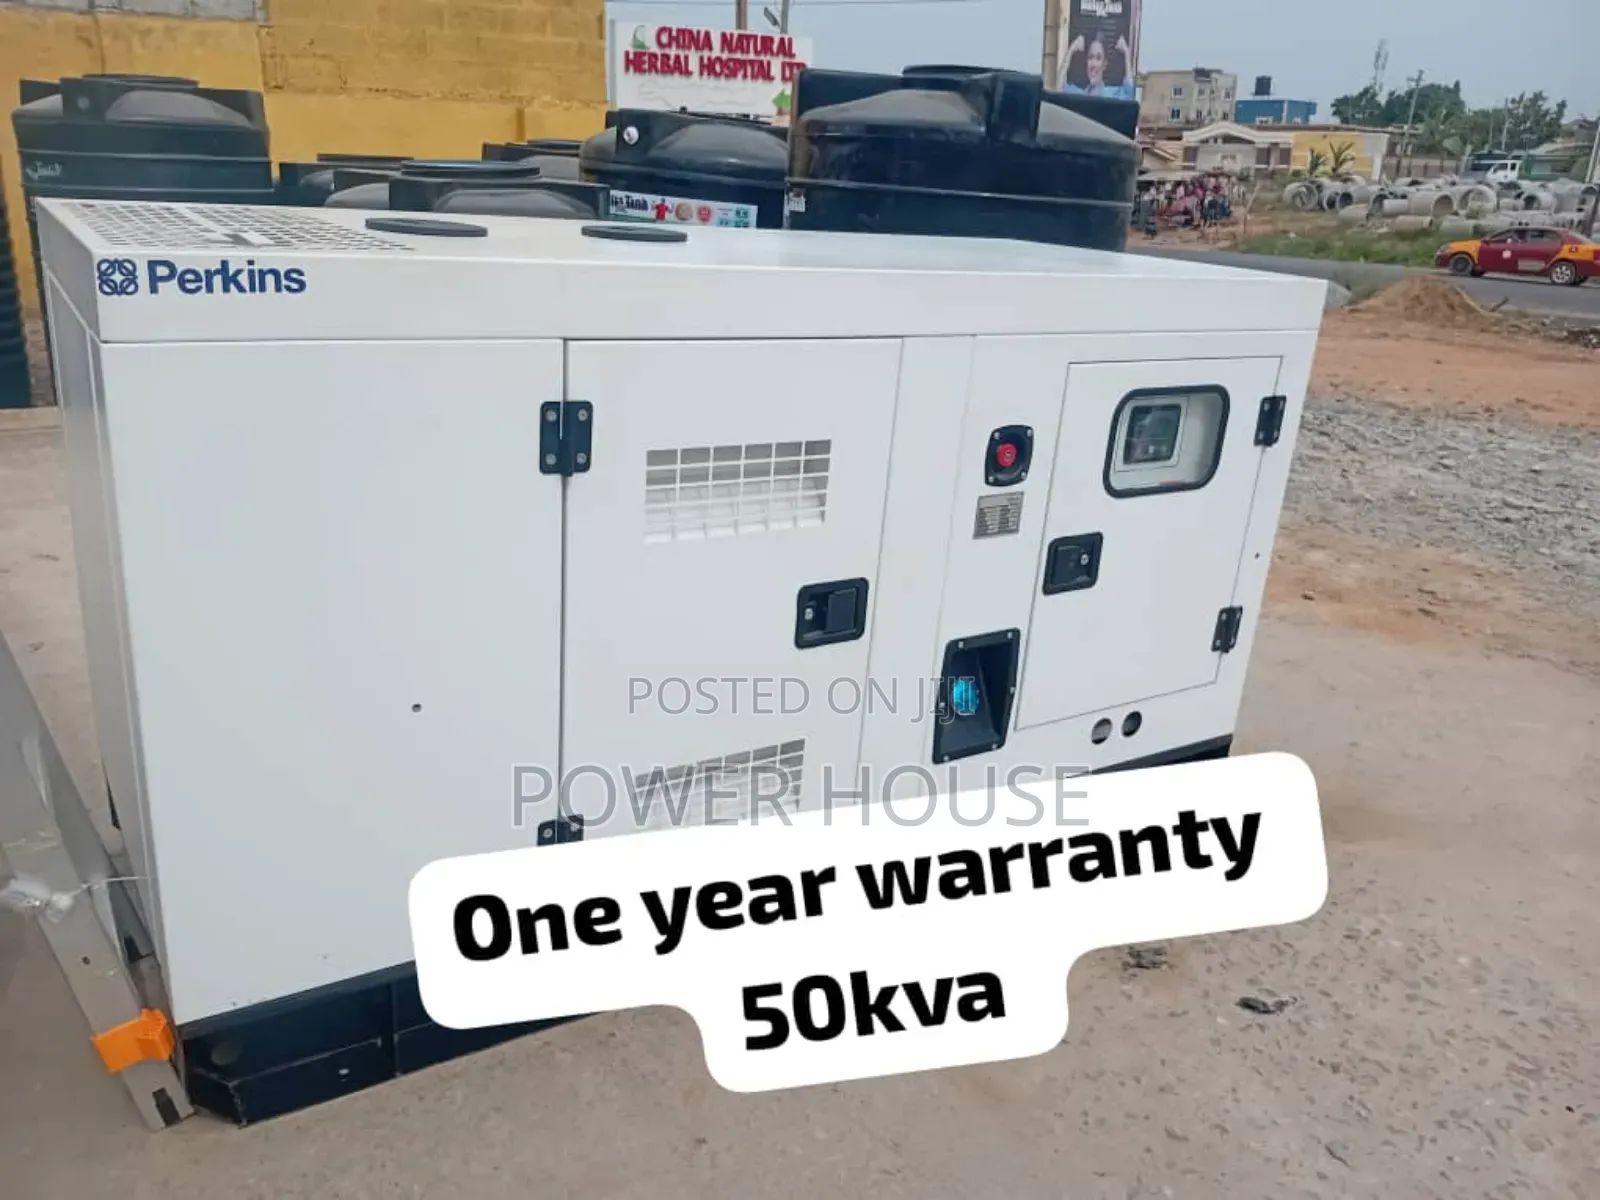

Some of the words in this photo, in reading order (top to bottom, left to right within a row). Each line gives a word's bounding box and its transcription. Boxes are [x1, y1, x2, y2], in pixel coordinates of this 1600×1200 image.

[656, 26, 714, 51] CHINA
[720, 32, 796, 58] NATURAL
[624, 51, 692, 76] HERBAL
[699, 55, 775, 81] HOSPITAL
[148, 260, 307, 295] Perkins
